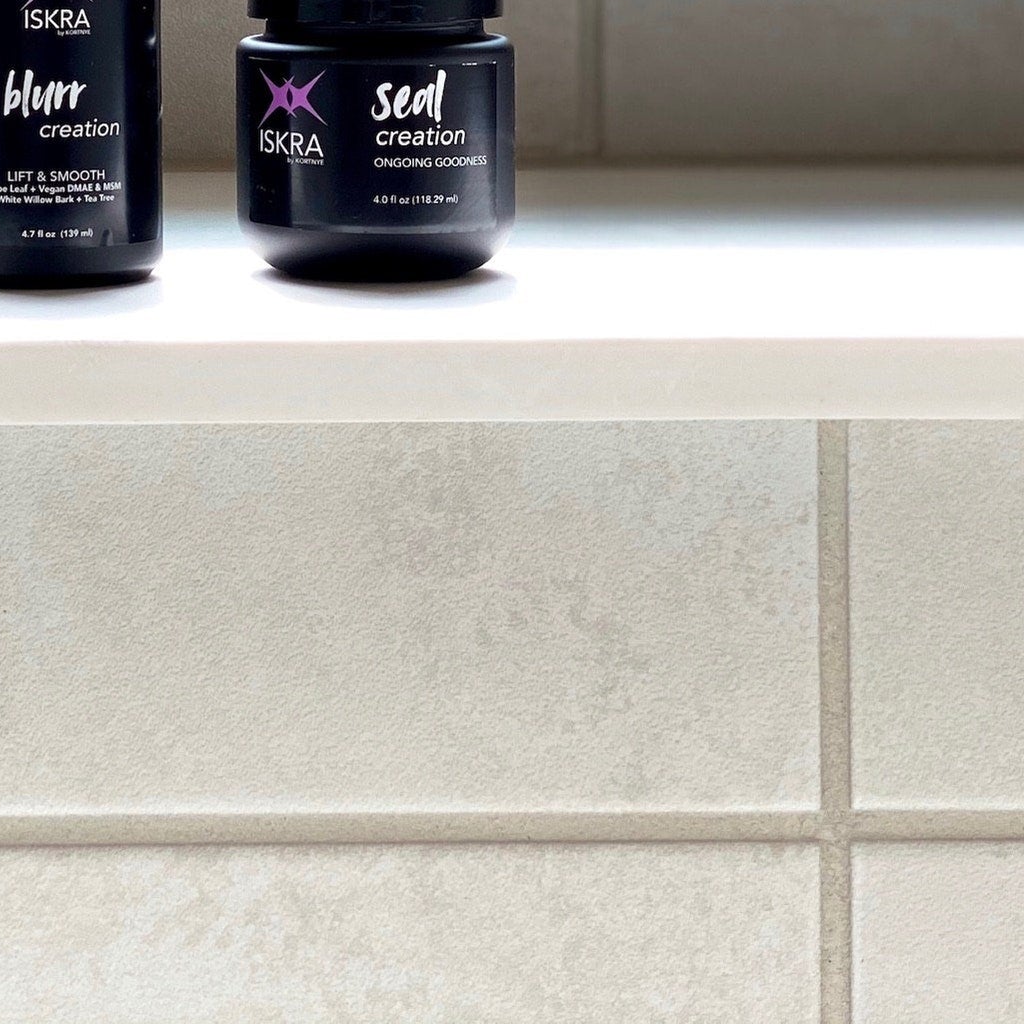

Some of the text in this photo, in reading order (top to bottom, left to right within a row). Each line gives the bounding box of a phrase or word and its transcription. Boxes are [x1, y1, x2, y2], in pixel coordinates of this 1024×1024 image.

[24, 8, 91, 29] ISKRA
[3, 69, 87, 118] blurr
[371, 69, 447, 123] seal
[39, 118, 120, 138] creation
[376, 124, 466, 146] creation
[260, 129, 324, 157] ISKRA
[373, 155, 487, 168] ONGOING GOODNESS
[7, 169, 105, 182] LIFT & SMOOTH
[10, 183, 29, 193] Leaf
[38, 184, 65, 195] Vegan
[67, 183, 93, 192] DMAE
[94, 182, 101, 191] &
[103, 181, 121, 190] MSM
[23, 195, 53, 204] Willow
[55, 195, 74, 203] Bark
[84, 194, 97, 202] Tea
[373, 194, 459, 205] 4.0 fl oz (118.29 ml)
[21, 230, 35, 238] 4.7
[60, 229, 79, 238] (139
[80, 228, 94, 237] ml)
